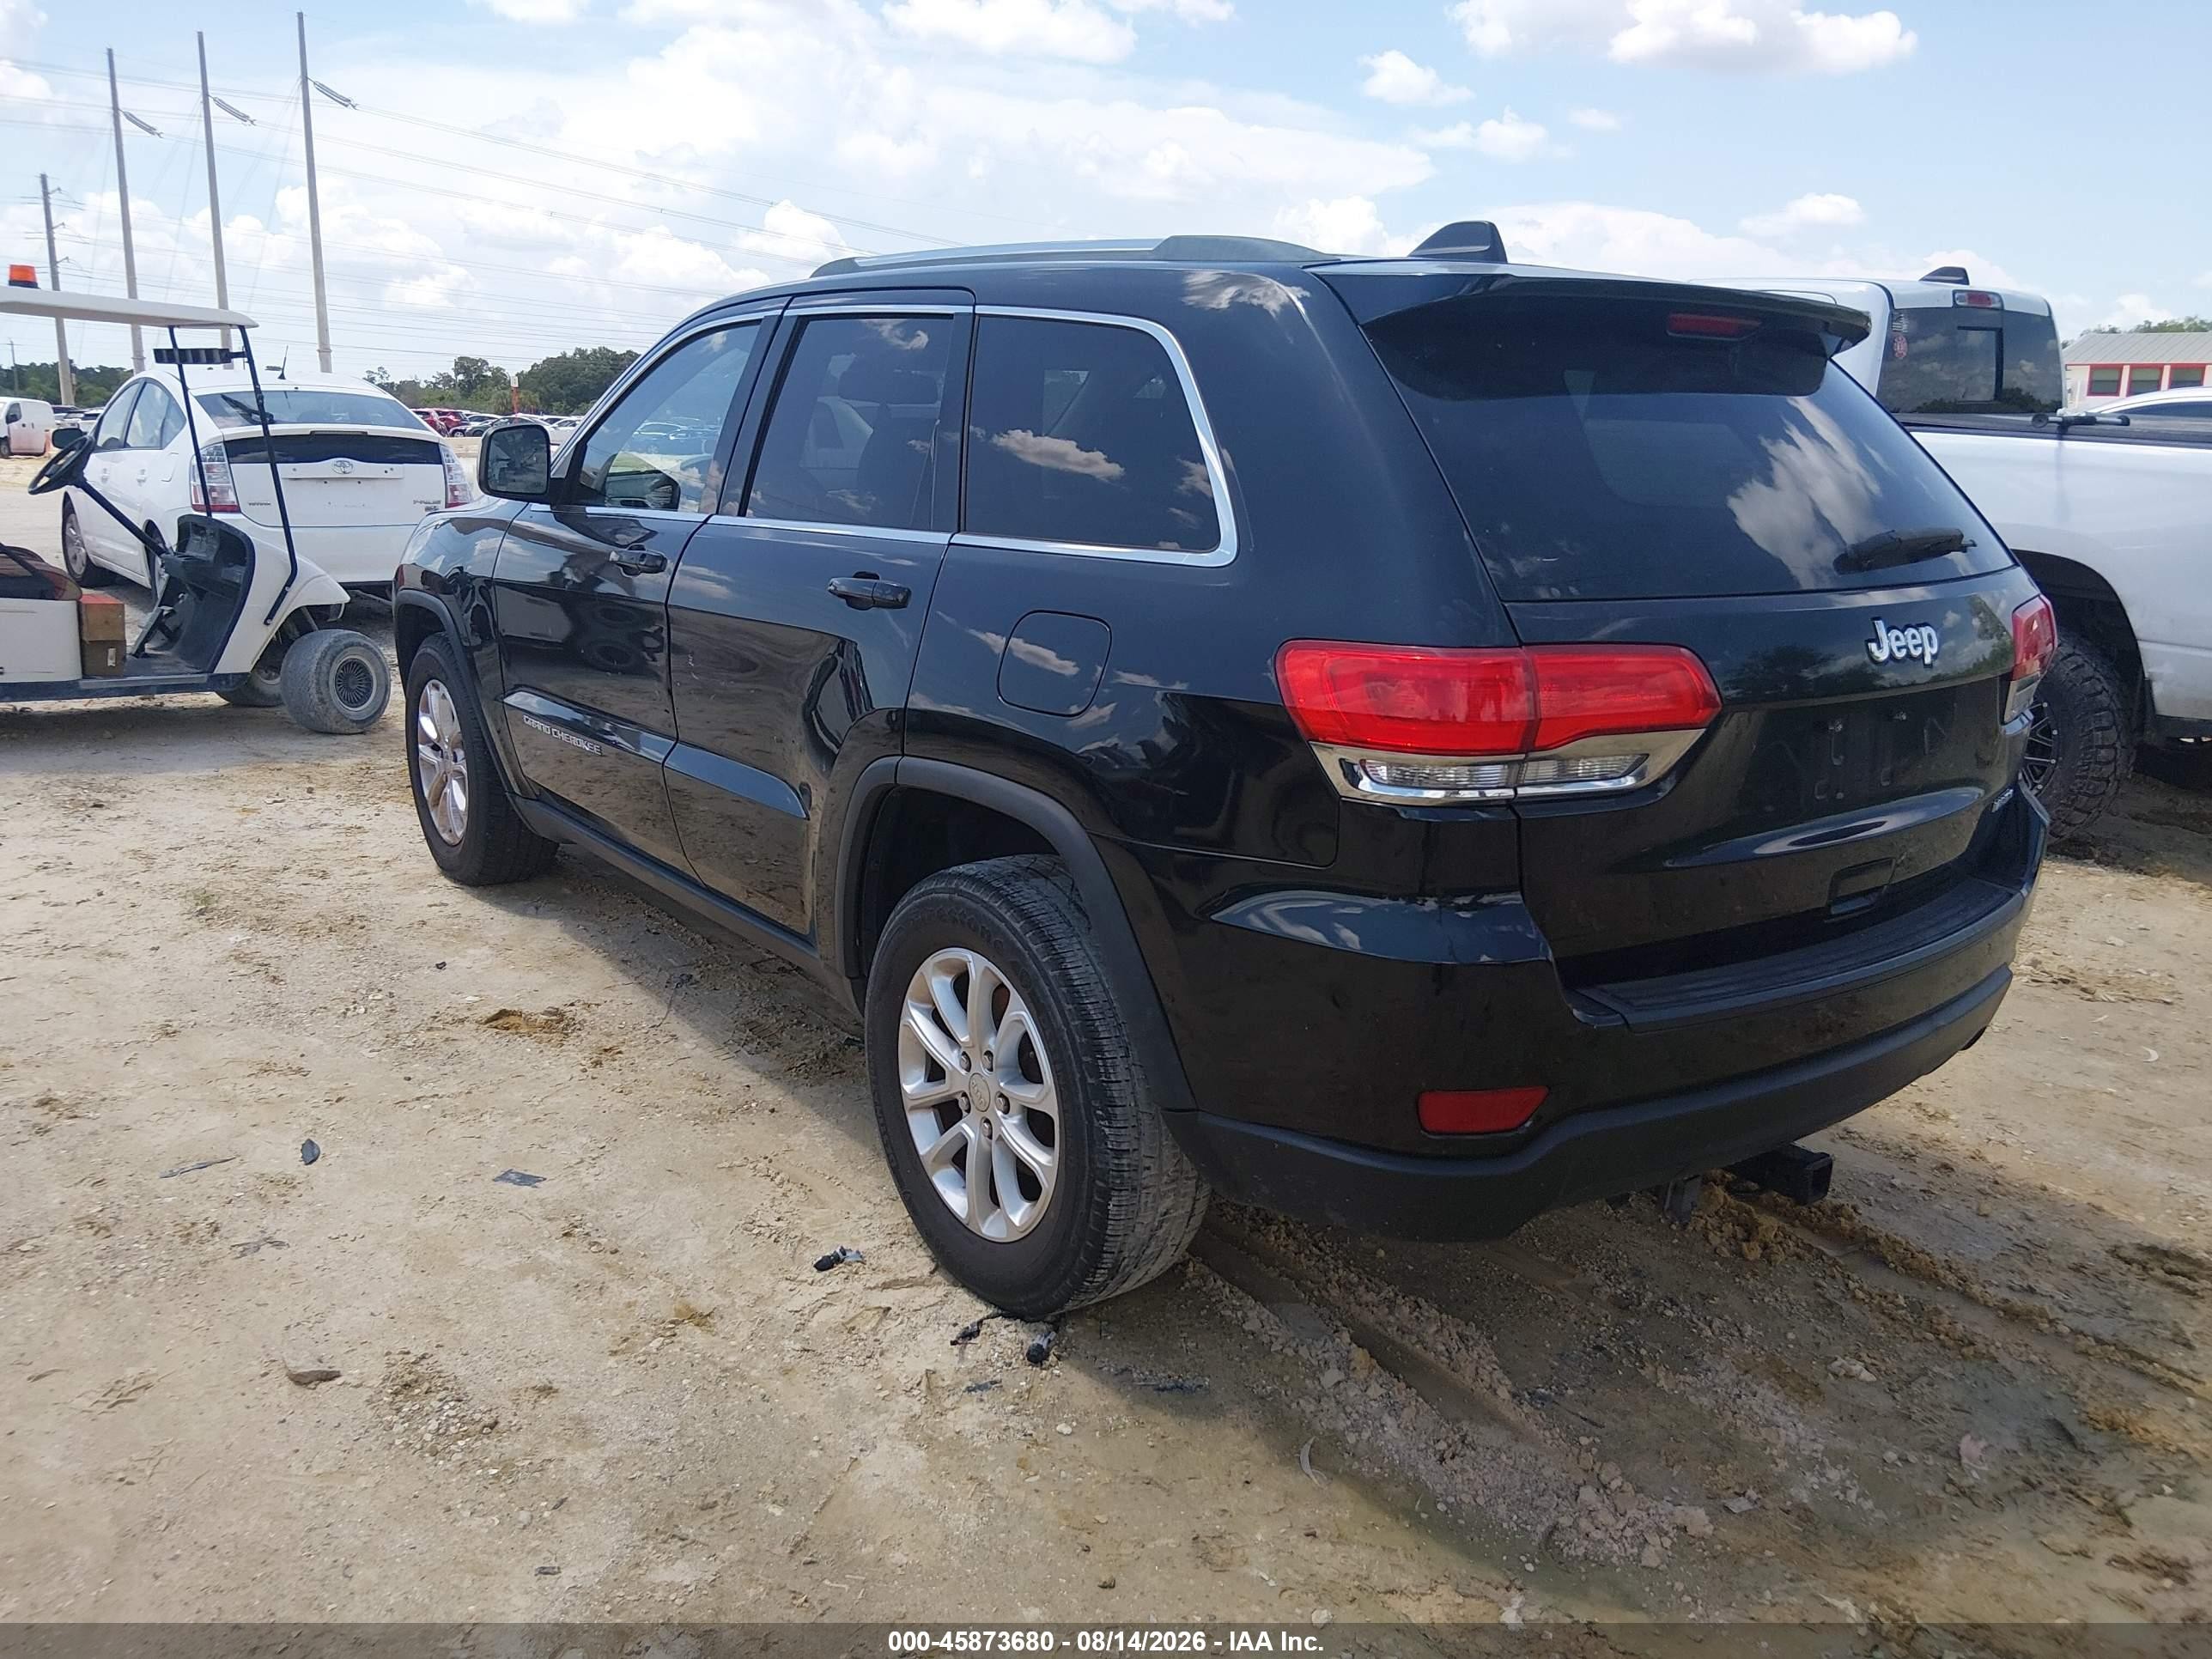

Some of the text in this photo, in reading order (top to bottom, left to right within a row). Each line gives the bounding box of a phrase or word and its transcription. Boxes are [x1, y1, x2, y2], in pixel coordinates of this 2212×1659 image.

[1867, 618, 1938, 665] Jeep
[523, 715, 603, 756] GRAND CHEROKEE
